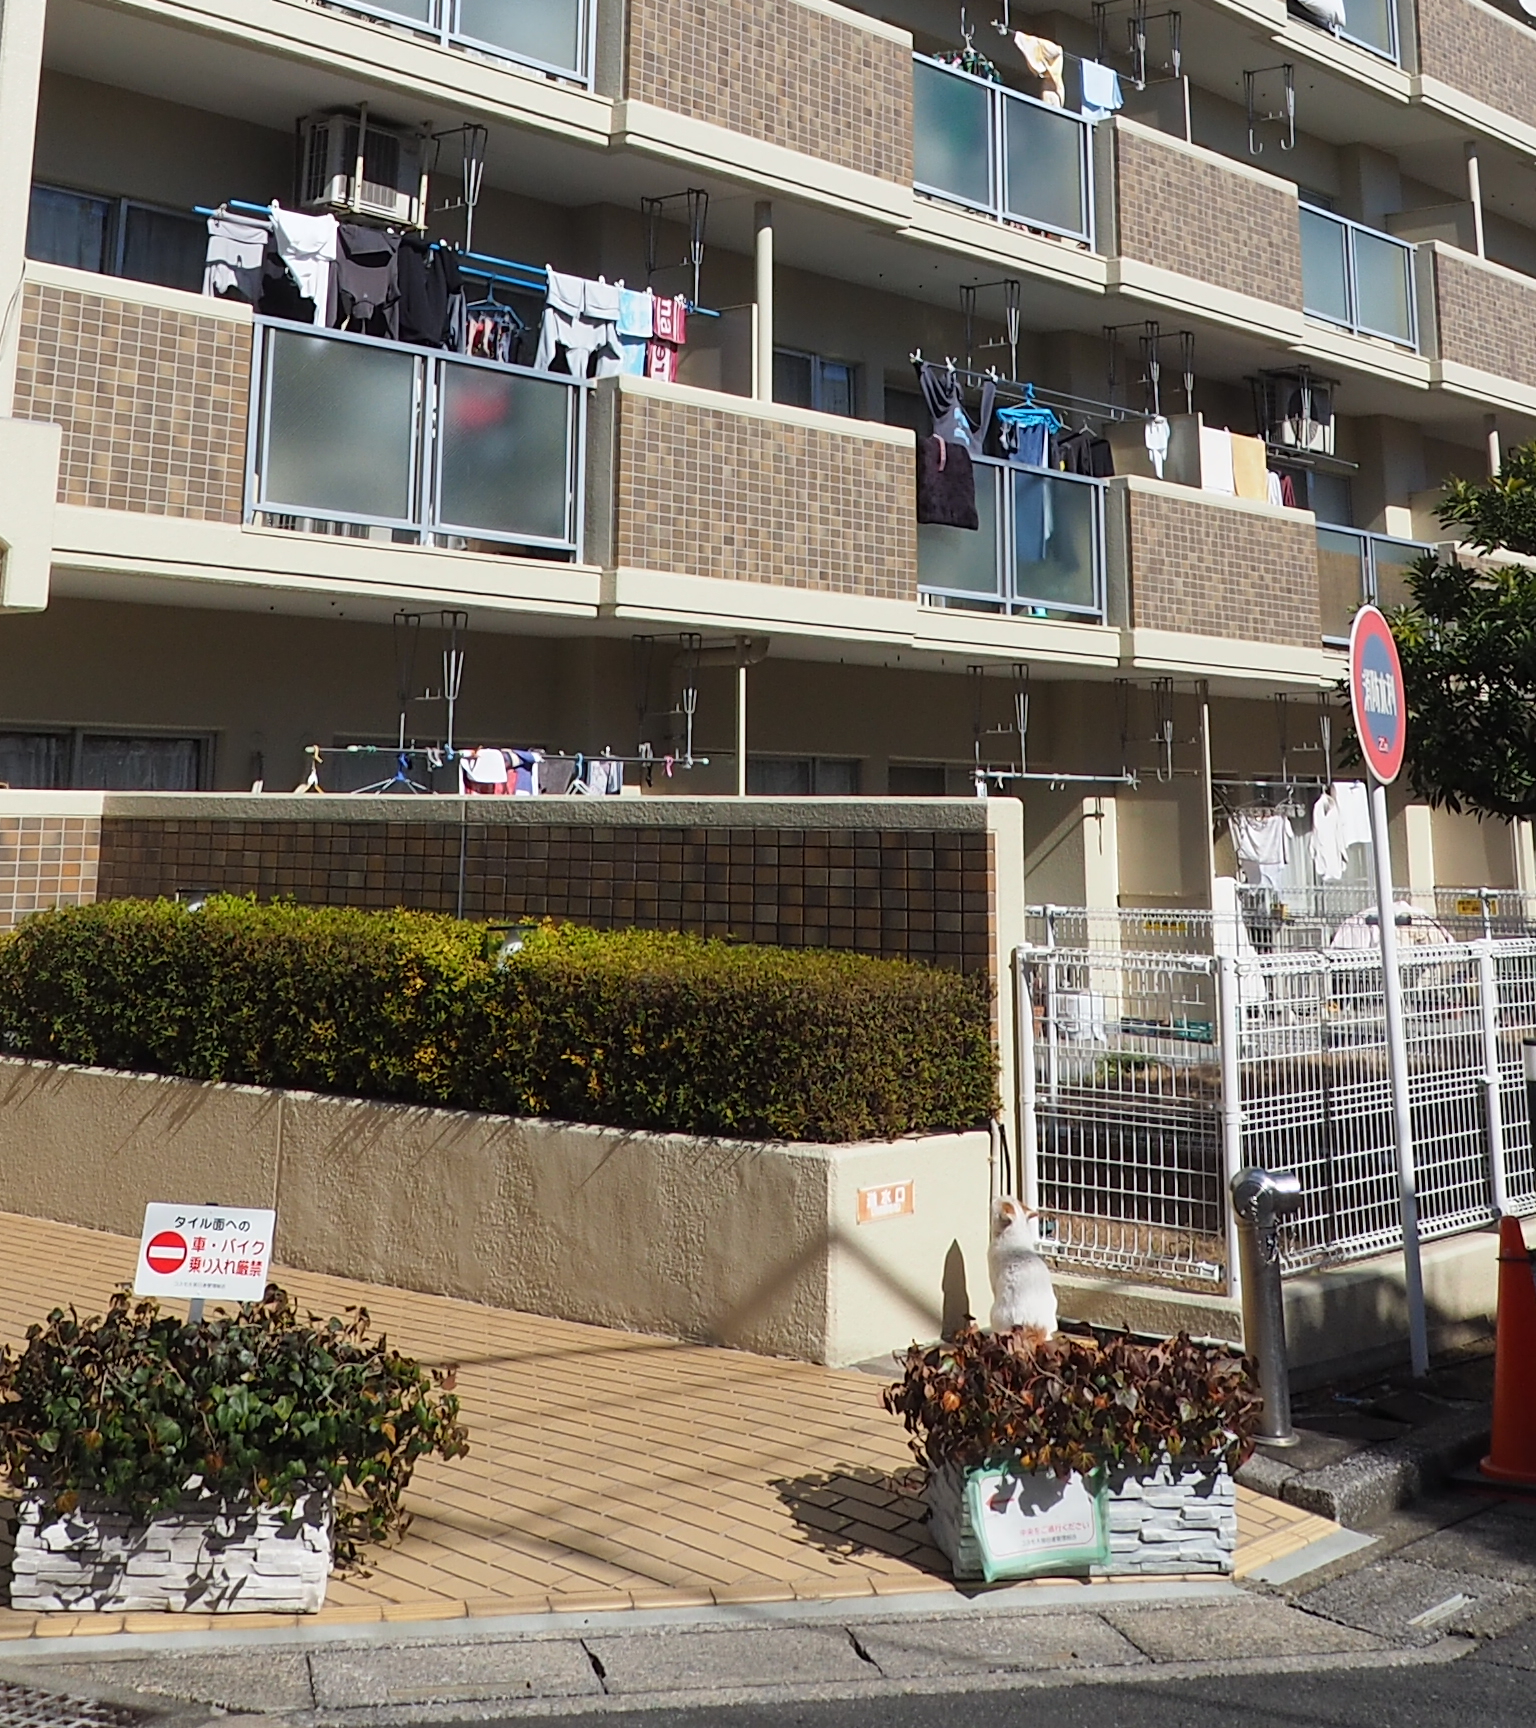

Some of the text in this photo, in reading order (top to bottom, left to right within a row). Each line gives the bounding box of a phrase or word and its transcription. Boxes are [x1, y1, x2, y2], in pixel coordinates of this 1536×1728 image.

[1361, 668, 1397, 717] 消防水利
[174, 1216, 251, 1232] タイル面への
[191, 1236, 265, 1255] 車・バイク
[189, 1256, 262, 1277] 乗り入れ厳禁
